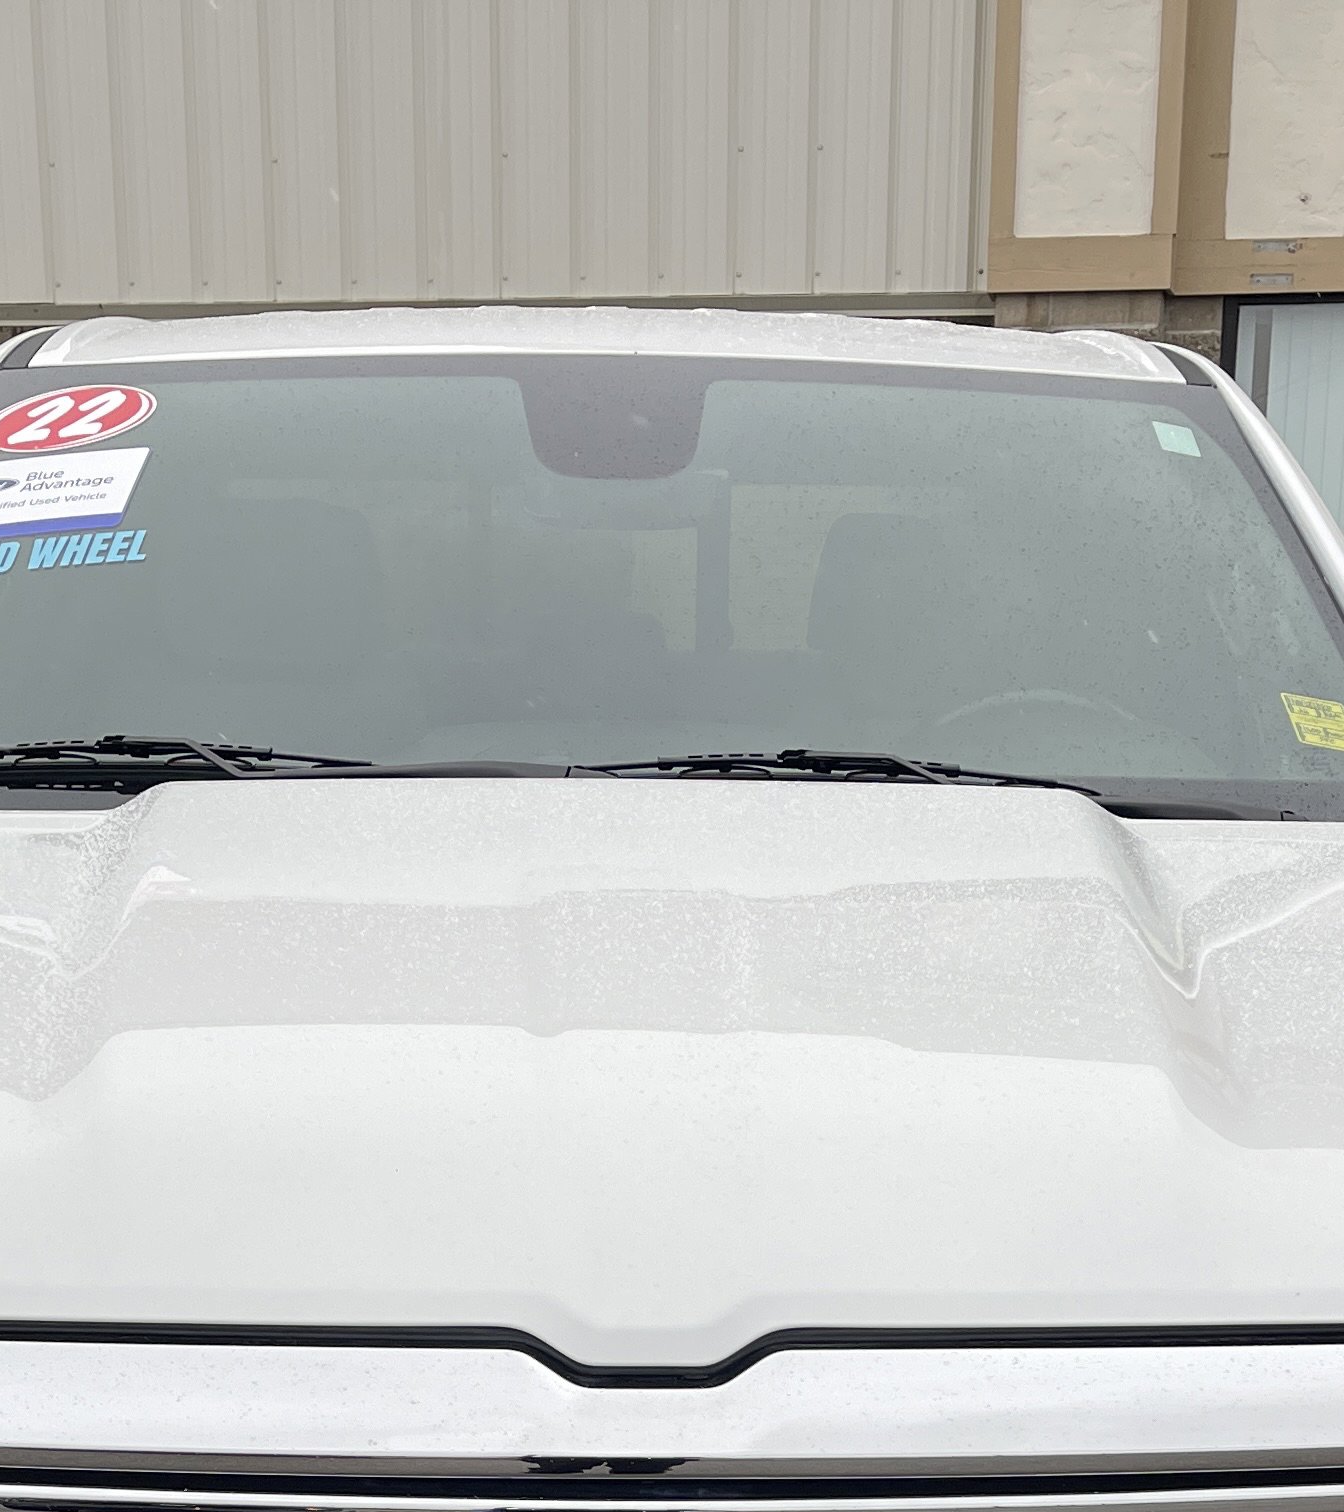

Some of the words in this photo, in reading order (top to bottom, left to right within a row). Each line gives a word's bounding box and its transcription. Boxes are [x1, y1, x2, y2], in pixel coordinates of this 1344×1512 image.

[7, 390, 126, 445] 22
[20, 476, 114, 493] Advantage
[26, 470, 64, 482] Blue
[29, 497, 61, 507] Used
[64, 492, 107, 503] Vehicle
[26, 529, 148, 570] WHEEL
